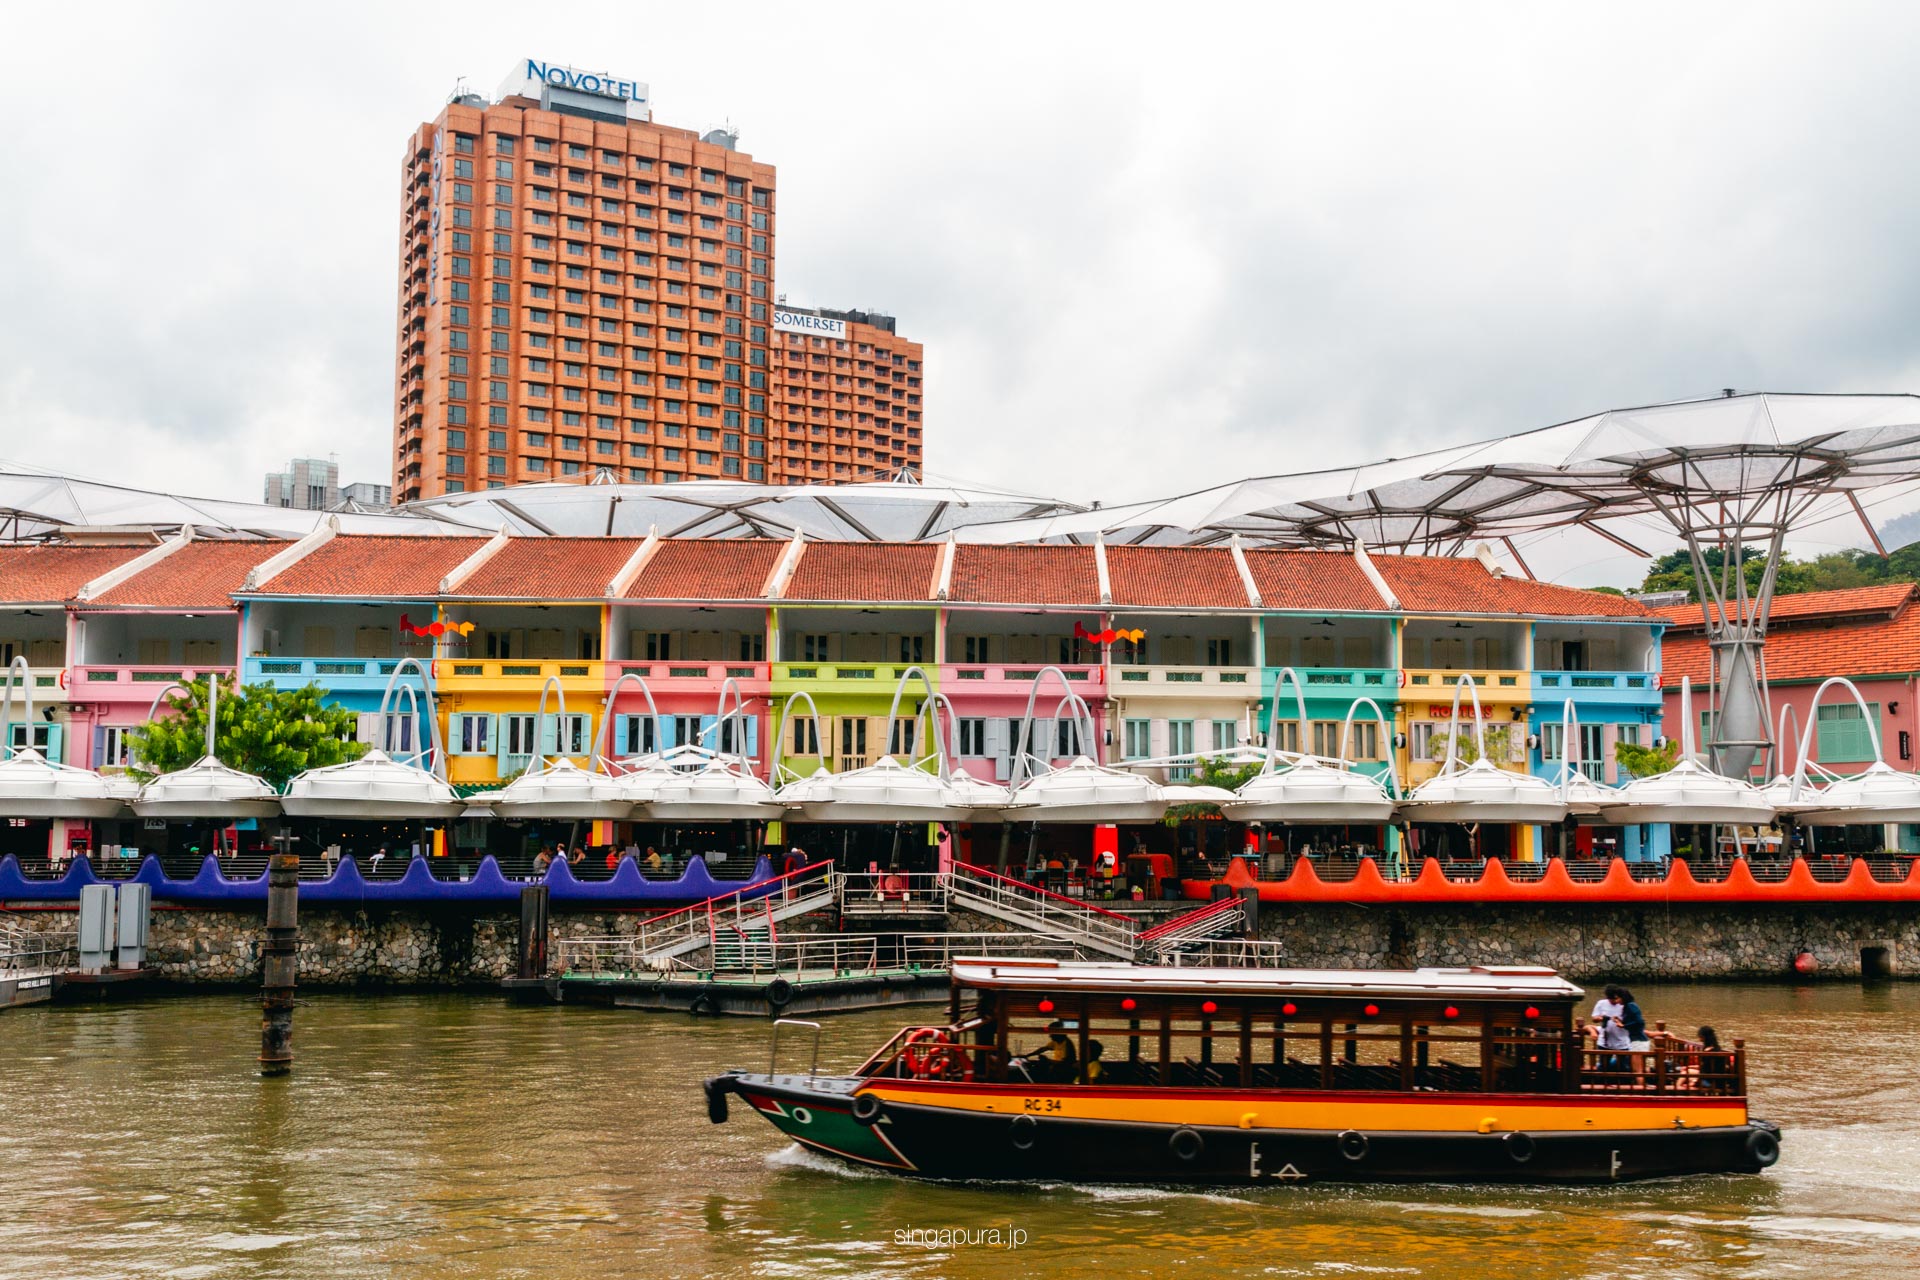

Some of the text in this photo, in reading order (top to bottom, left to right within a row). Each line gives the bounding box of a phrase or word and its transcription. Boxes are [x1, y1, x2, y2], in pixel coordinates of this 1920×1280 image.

[527, 59, 646, 102] NOVOTEL
[430, 127, 443, 306] NOVOTEL
[774, 312, 843, 332] SOMERSET
[1024, 1098, 1062, 1111] RC 34
